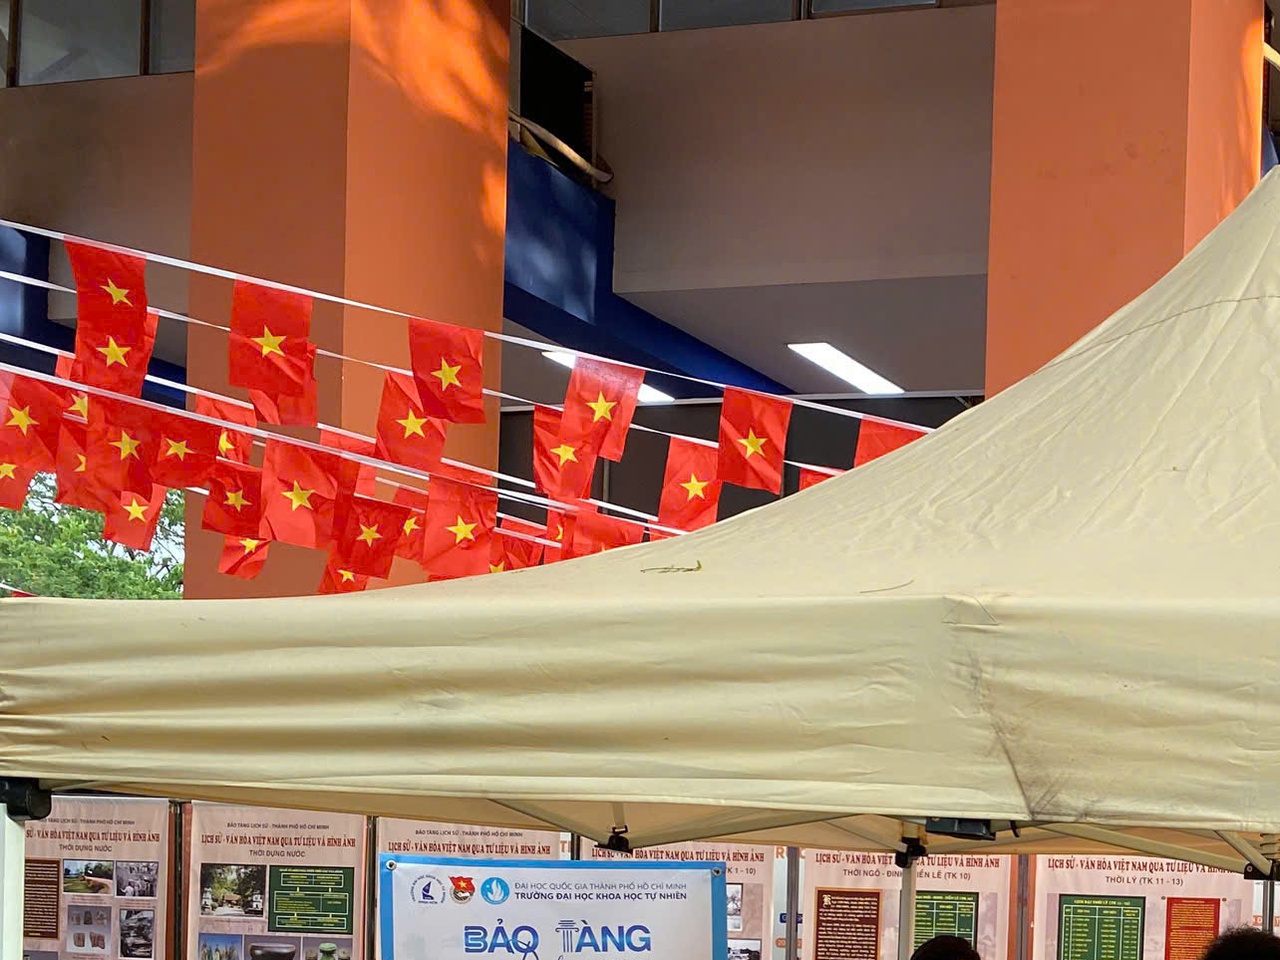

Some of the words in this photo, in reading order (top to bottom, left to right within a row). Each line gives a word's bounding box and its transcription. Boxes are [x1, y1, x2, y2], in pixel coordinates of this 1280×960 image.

[816, 852, 831, 863] LỊCH
[832, 850, 841, 863] SỬ
[846, 852, 860, 864] VĂN
[862, 852, 876, 864] HÓA
[877, 852, 893, 866] VIỆT
[938, 854, 953, 868] LIỆU
[954, 856, 964, 868] VÀ
[966, 855, 983, 868] HÌNH
[984, 854, 1000, 868] ẢNH
[1048, 858, 1063, 870] LỊCH
[1065, 856, 1075, 869] SỬ
[1080, 858, 1096, 870] VĂN
[1097, 858, 1111, 870] HÓA
[1113, 859, 1129, 872] VIỆT
[1131, 861, 1147, 871] NAM
[1149, 862, 1164, 874] QUA
[1166, 861, 1177, 872] TƯ
[1177, 862, 1193, 874] LIỆU
[843, 868, 861, 877] THỜI
[863, 868, 879, 878] NGÔ
[932, 870, 942, 879] LÊ
[944, 870, 957, 881] (TK
[960, 872, 970, 881] 10)
[1106, 876, 1124, 884] THỜI
[1126, 876, 1136, 884] LÝ
[1139, 876, 1153, 886] (TK
[1172, 877, 1183, 886] 13)
[515, 882, 528, 891] ĐẠI
[530, 882, 547, 891] HỌC
[549, 881, 572, 891] QUỐC
[574, 882, 588, 890] GIA
[590, 881, 616, 890] THÀNH
[619, 881, 634, 890] PHỐ
[637, 881, 649, 890] HỒ
[650, 882, 663, 890] CHÍ
[666, 882, 687, 890] MINH
[515, 891, 554, 900] TRƯỜNG
[556, 892, 572, 901] ĐẠI
[575, 892, 593, 901] HỌC
[596, 892, 621, 900] KHOA
[624, 892, 642, 901] HỌC
[645, 892, 657, 901] TỰ
[660, 891, 687, 900] NHIÊN
[464, 918, 539, 954] BẢO
[555, 920, 651, 953] TÀNG
